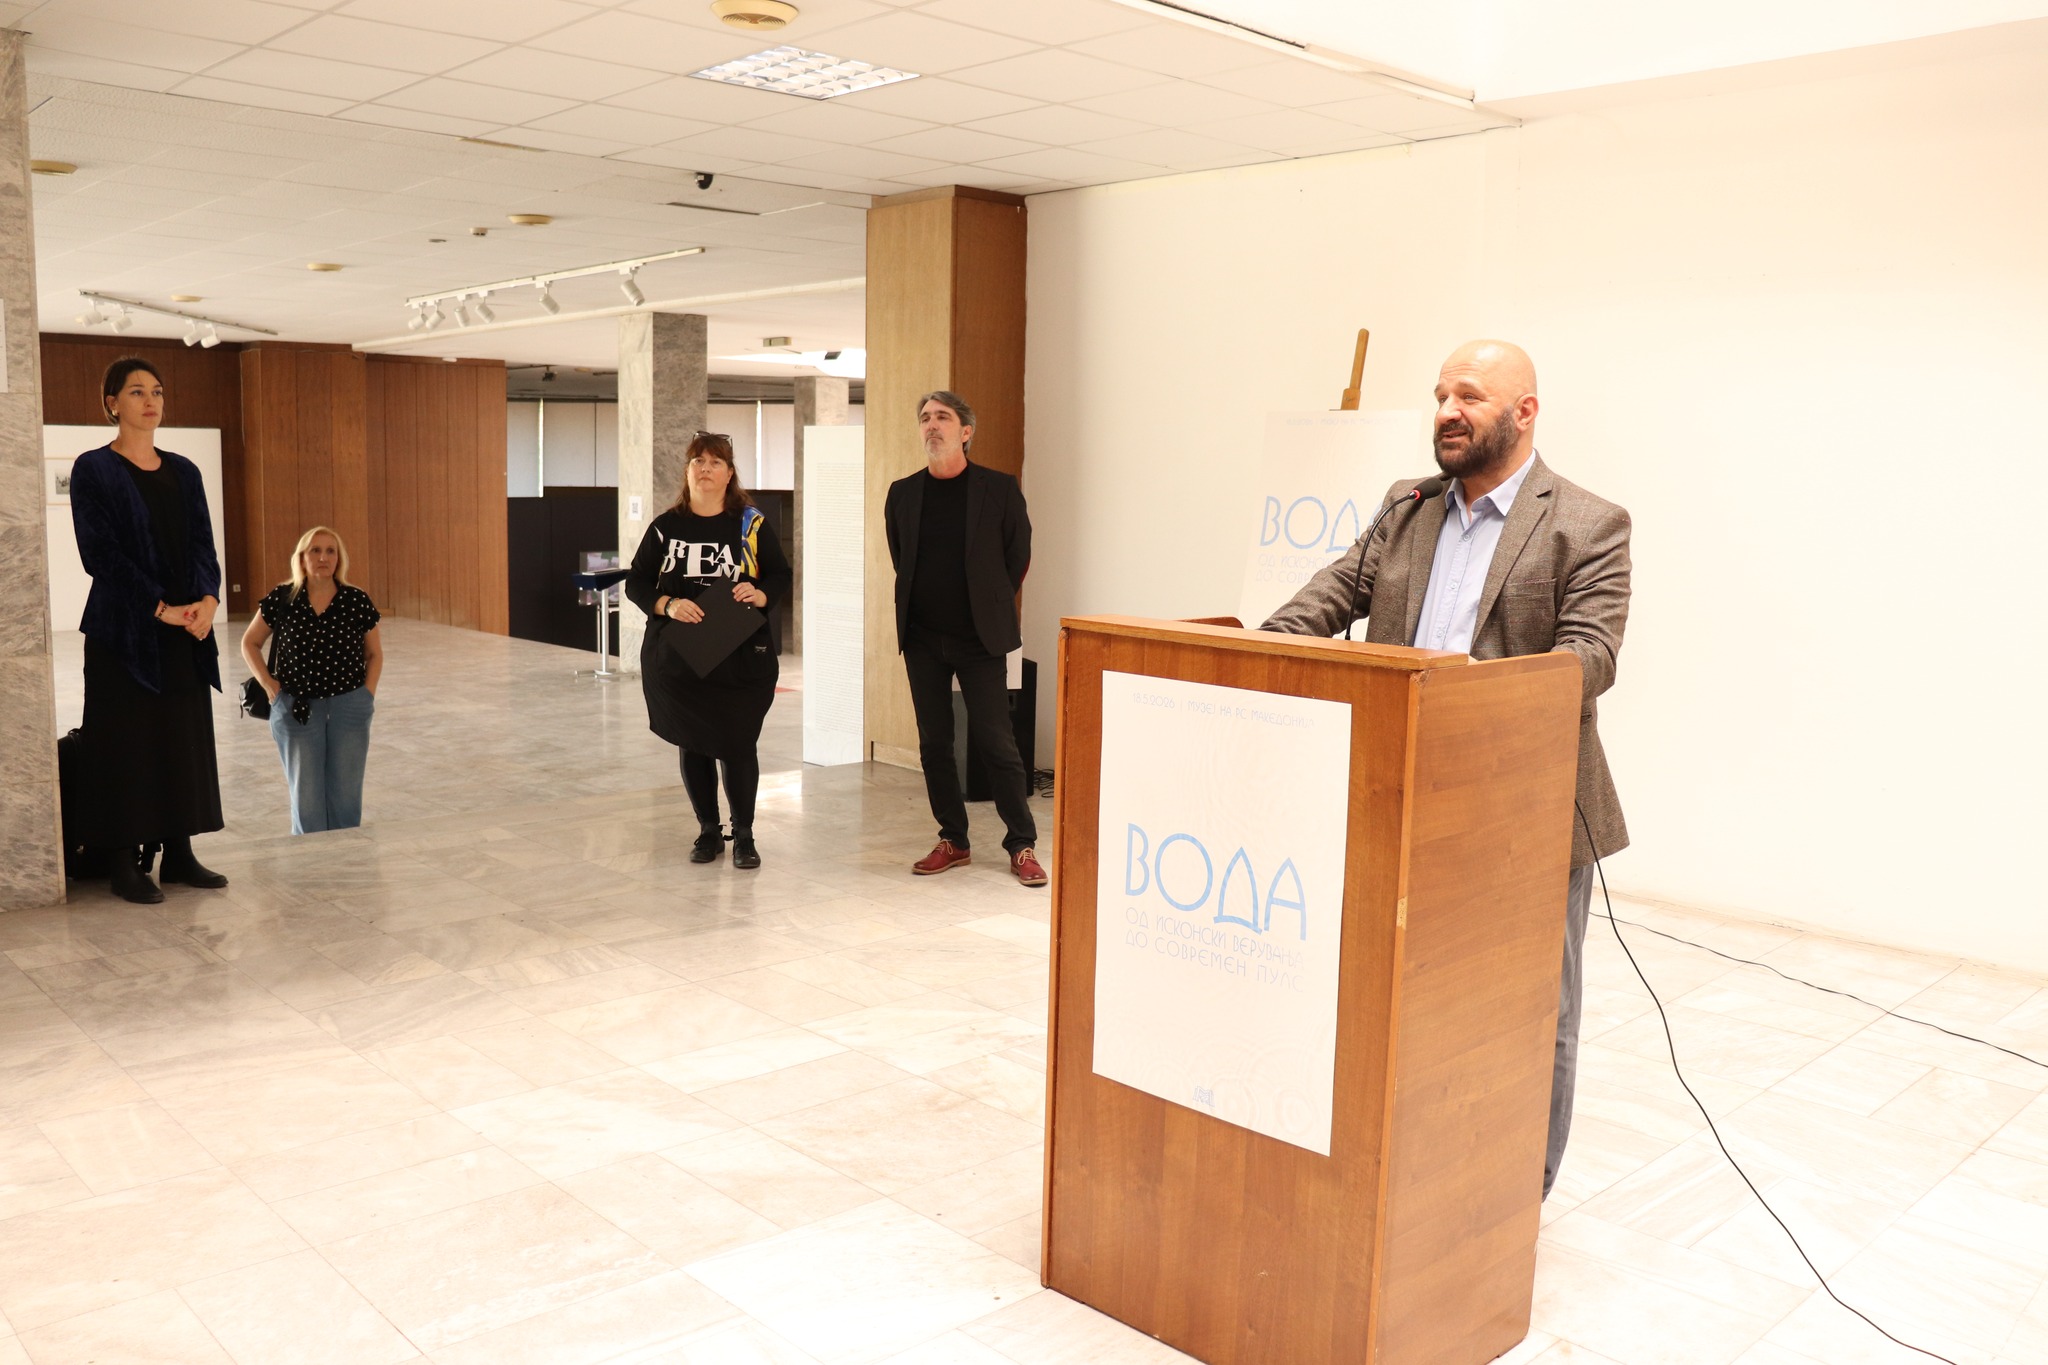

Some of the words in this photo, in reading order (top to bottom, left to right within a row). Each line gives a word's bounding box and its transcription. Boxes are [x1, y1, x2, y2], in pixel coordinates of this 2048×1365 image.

[1260, 495, 1382, 553] ВОД
[661, 538, 742, 583] DREAM
[1132, 692, 1175, 709] 18.5.2026
[1187, 700, 1215, 715] МУЗЕЈ
[1220, 705, 1232, 718] НА
[1235, 707, 1247, 720] РС
[1125, 822, 1307, 942] ВОДА
[1125, 907, 1149, 929] ОД
[1156, 914, 1226, 949] ИСКОНСКИ
[1232, 935, 1305, 970] ВЕРУВАЊА
[1125, 929, 1148, 948] ДО
[1154, 936, 1247, 977] СОВРЕМЕН
[1257, 964, 1304, 993] ПУЛС
